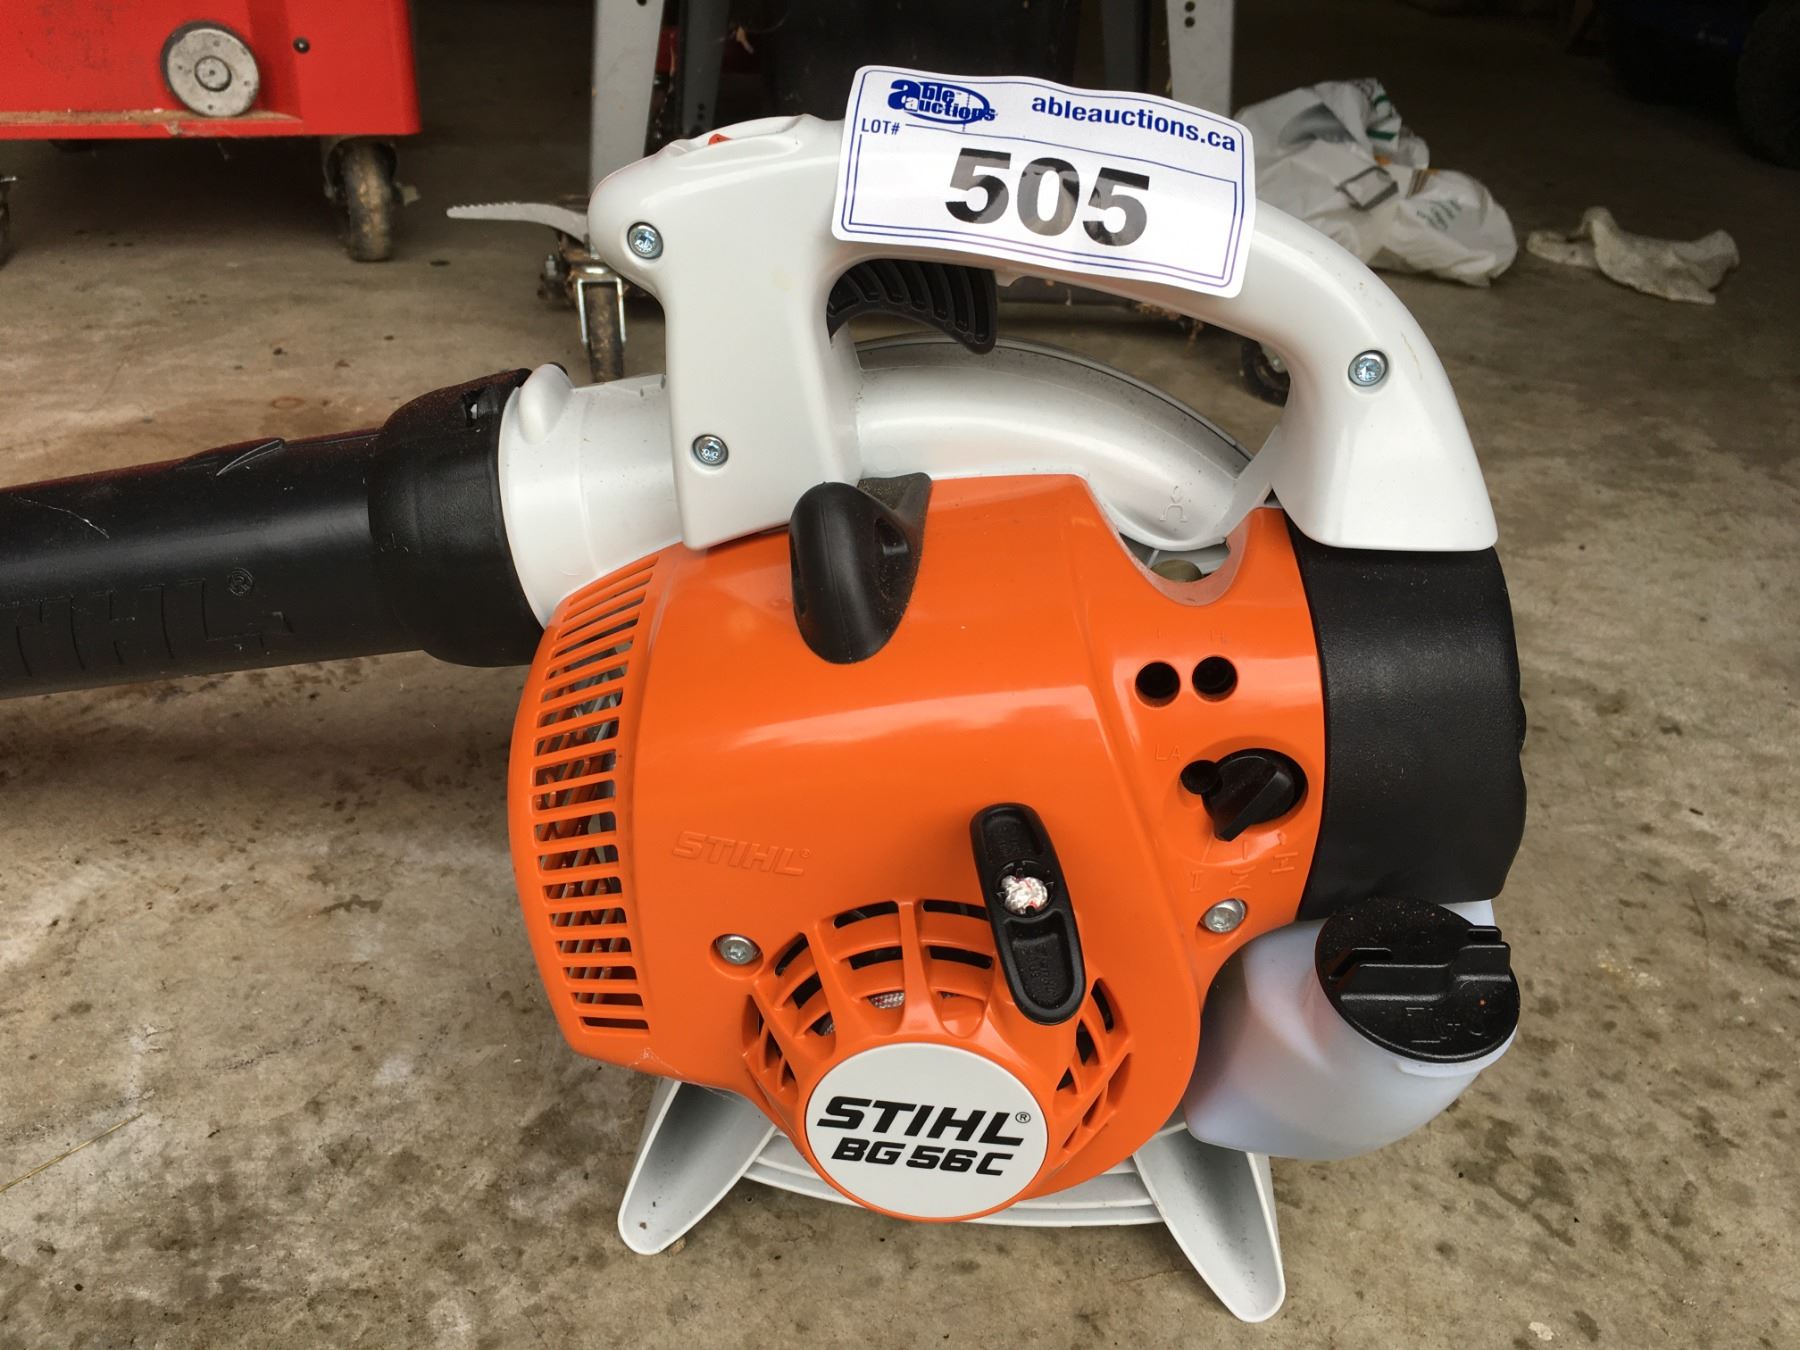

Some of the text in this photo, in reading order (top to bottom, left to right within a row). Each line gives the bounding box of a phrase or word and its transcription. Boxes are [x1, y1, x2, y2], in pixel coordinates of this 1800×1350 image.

[861, 118, 900, 135] LOT#
[903, 97, 997, 121] auctions
[1032, 97, 1236, 152] ableauctions.ca
[945, 147, 1150, 247] 505
[831, 1137, 1014, 1176] BG 56C
